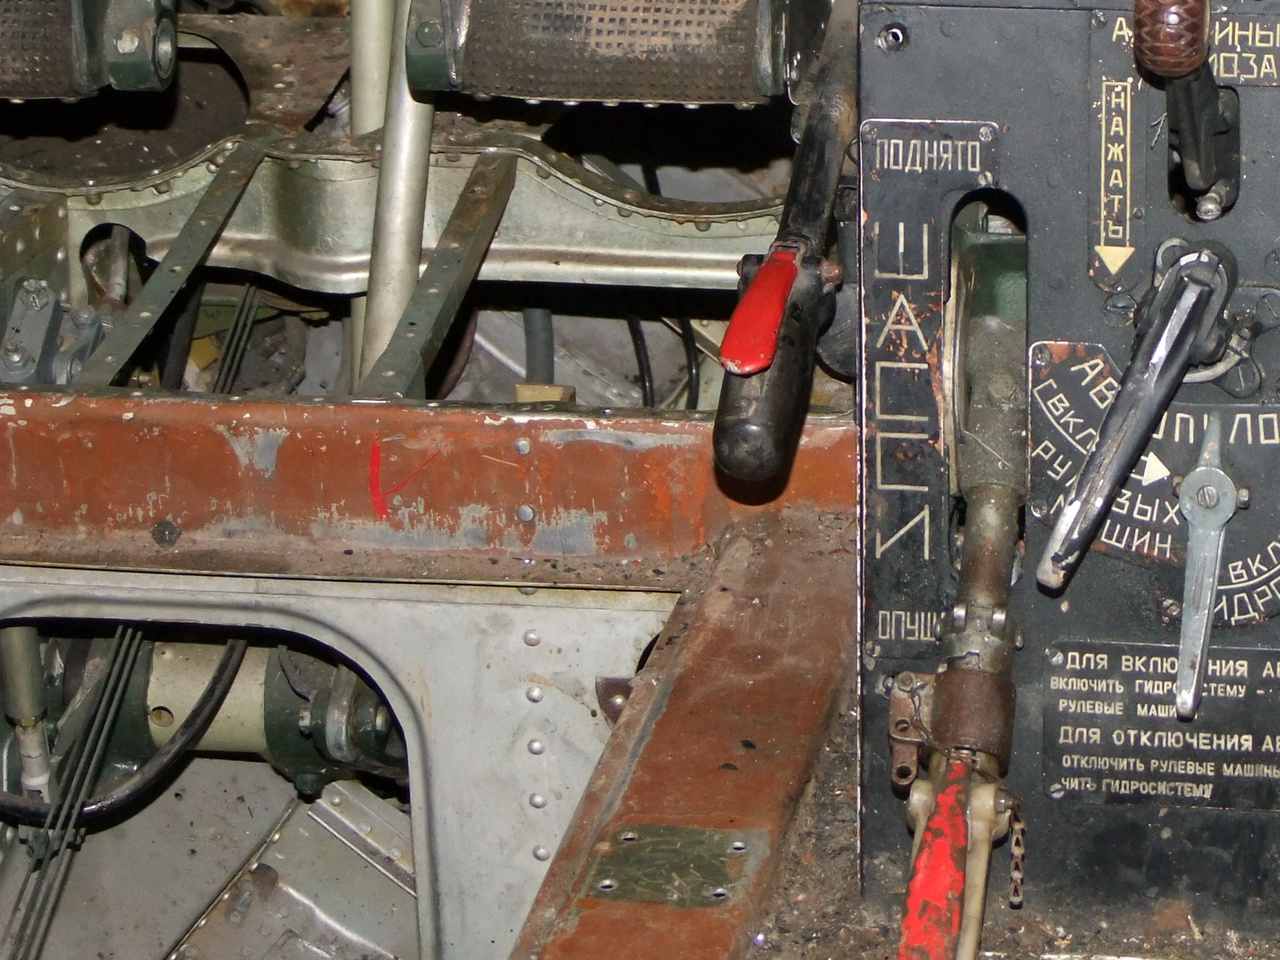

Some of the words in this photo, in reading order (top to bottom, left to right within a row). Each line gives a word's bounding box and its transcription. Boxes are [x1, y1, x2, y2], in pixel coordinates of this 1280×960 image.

[876, 139, 982, 174] ПОДНЯТО
[1107, 91, 1125, 239] НАЖАТЬ
[873, 221, 929, 561] ШАССИ
[1065, 651, 1109, 670] ДЛЯ
[1120, 655, 1249, 679] ВКЛЮНИЯ
[1050, 676, 1125, 694] ВКЛЮЧИТЬ
[1058, 698, 1125, 716] РУЛЕВЫЕ
[1058, 725, 1101, 745] ДЛЯ
[1113, 729, 1253, 752] ОТКЛЮЧЕНИЯ
[1062, 754, 1145, 772] ОТКЛЮЧИТЬ
[1150, 759, 1216, 777] РУЛЕВЫЕ
[1061, 777, 1097, 792] ЧИТЬ
[1102, 778, 1214, 800] ГИДРОСИСТЕМУ
